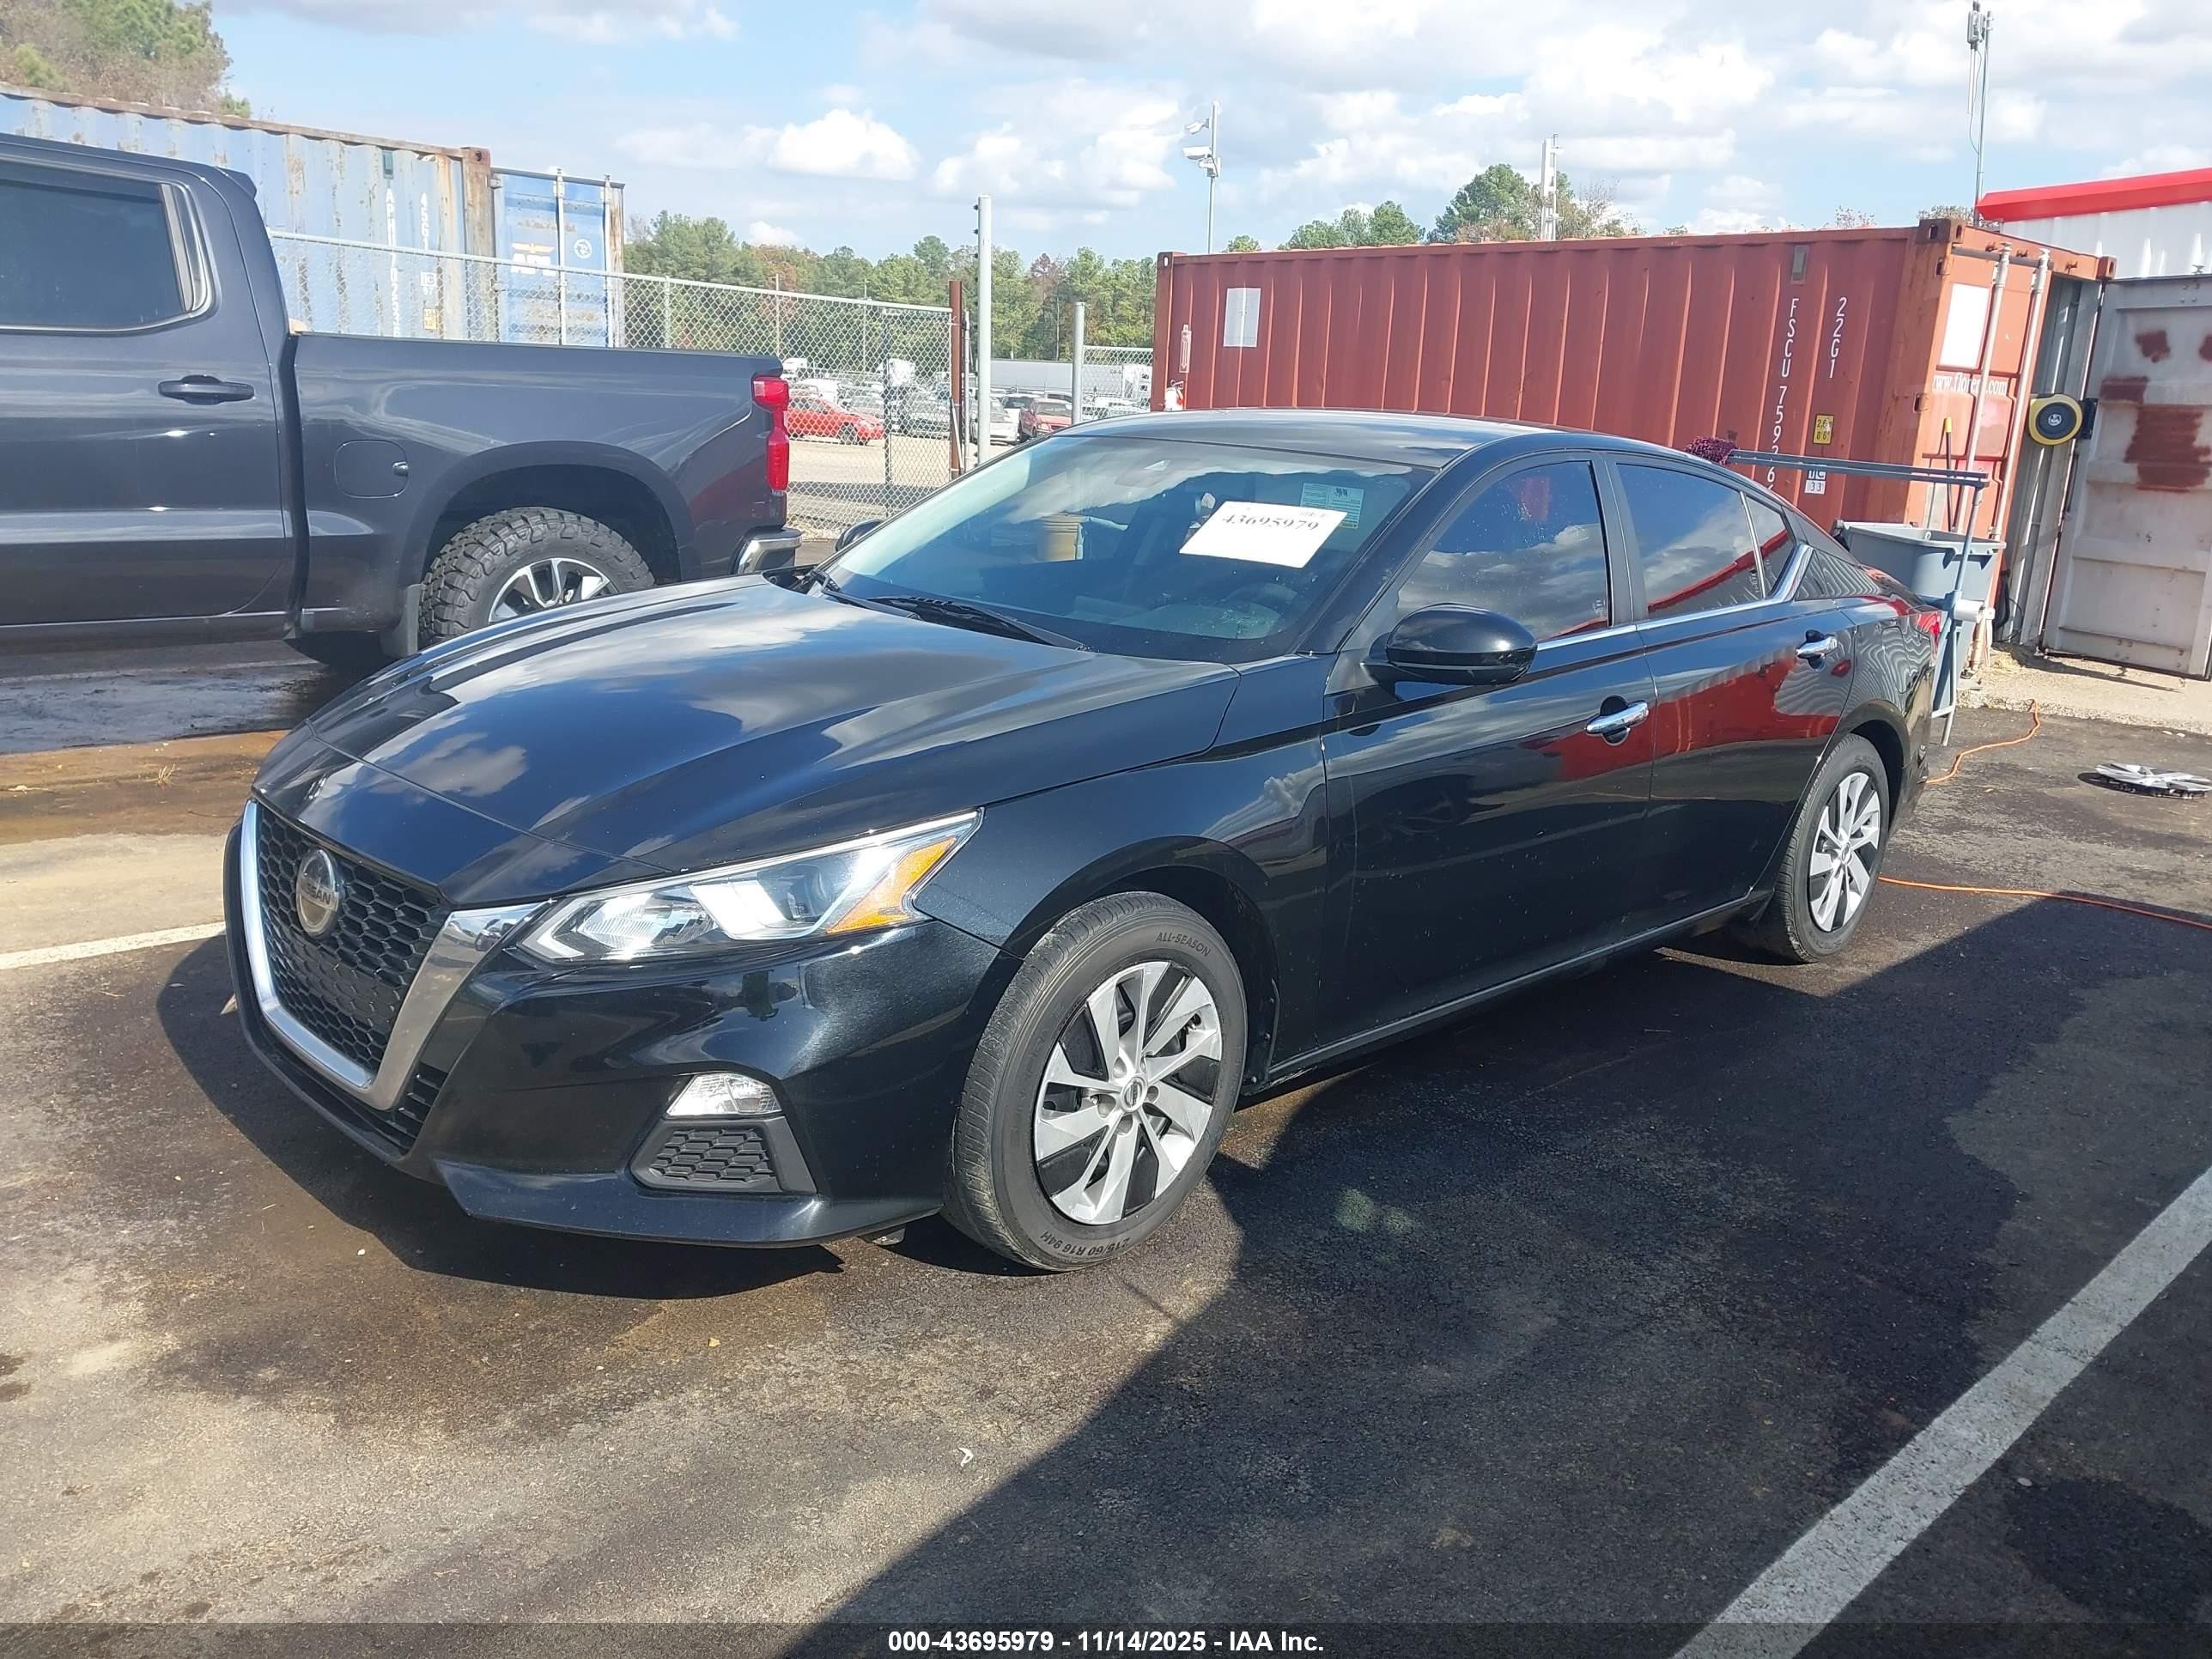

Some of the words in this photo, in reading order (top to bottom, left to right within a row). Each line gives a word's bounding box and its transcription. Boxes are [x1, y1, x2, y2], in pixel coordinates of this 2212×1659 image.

[1781, 298, 1799, 378] FSCU
[1829, 296, 1847, 379] 22G1
[1767, 386, 1787, 490] 75926
[1222, 514, 1320, 531] 43695979
[1155, 932, 1211, 957] ALL-SEASON
[1040, 1231, 1063, 1249] 94H
[1062, 1243, 1087, 1256] R16
[1087, 1237, 1131, 1256] 215/60
